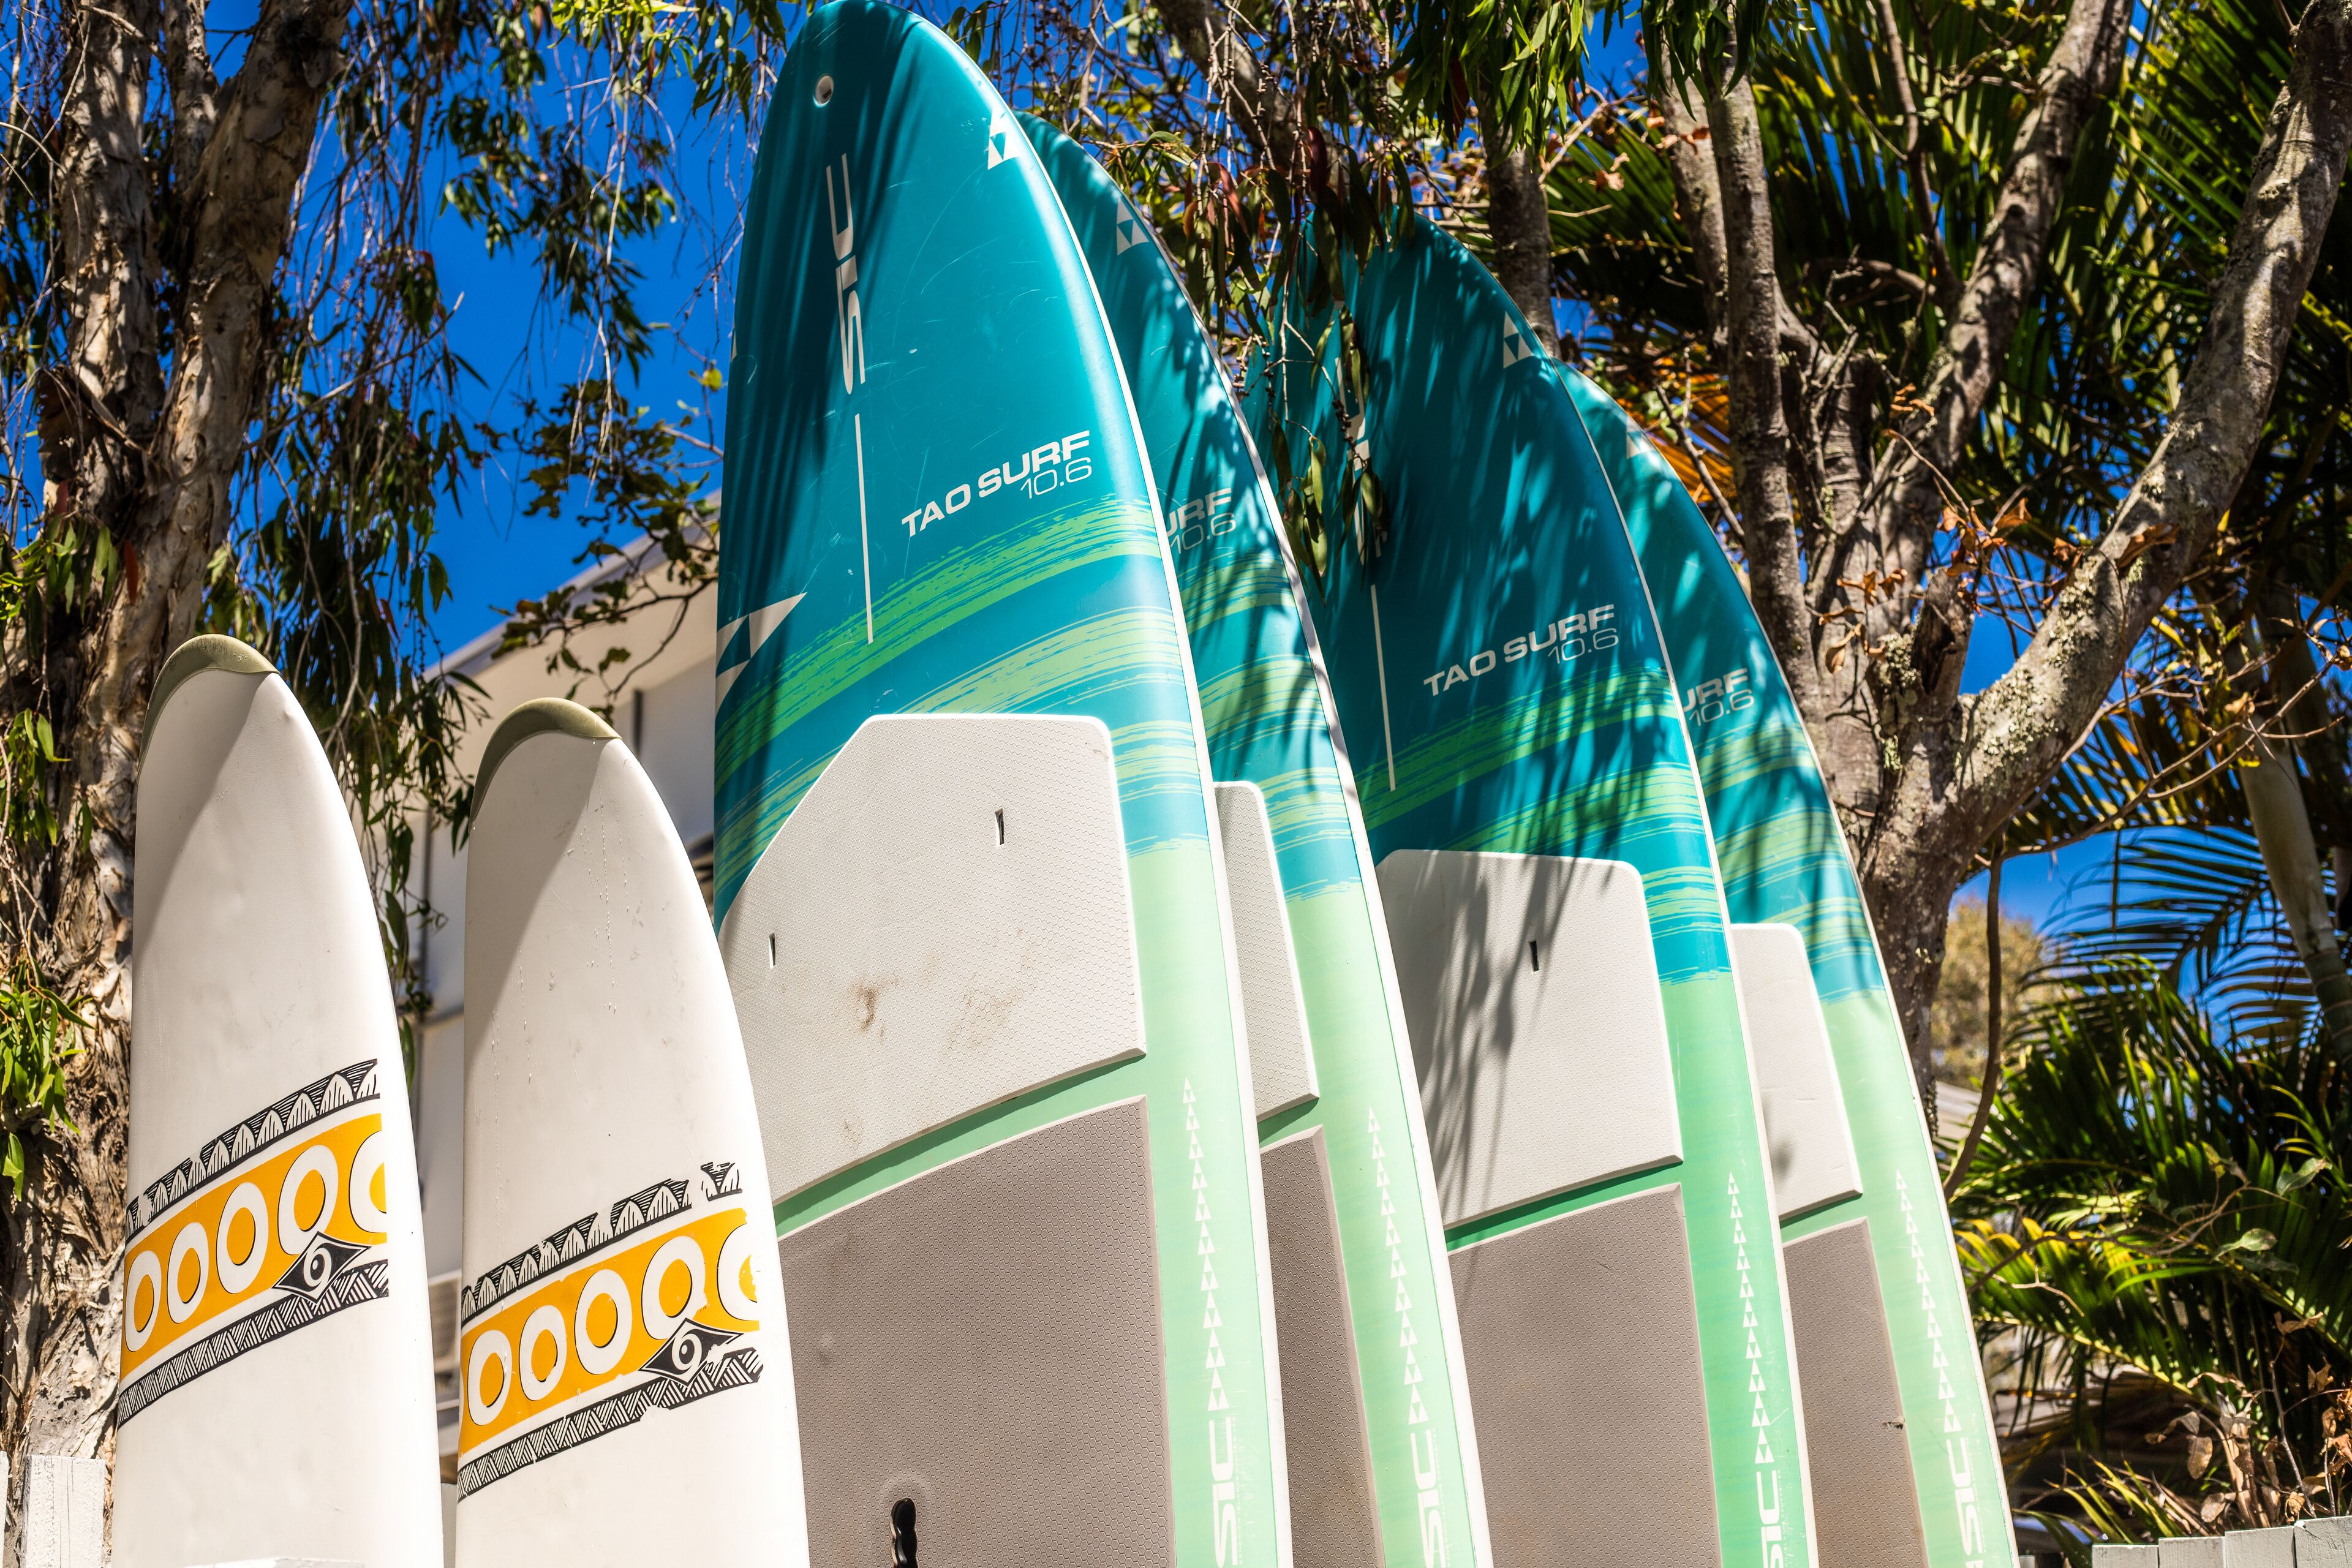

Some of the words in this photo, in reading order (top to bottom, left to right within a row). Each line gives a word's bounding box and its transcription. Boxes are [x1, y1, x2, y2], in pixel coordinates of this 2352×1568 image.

[827, 153, 865, 394] SIC
[902, 483, 971, 537] TAO
[978, 429, 1090, 498] SURF
[1020, 457, 1092, 499] 10.6
[1167, 488, 1232, 537] URF
[1170, 512, 1237, 554] 10.6
[1424, 650, 1496, 696] TAO
[1504, 604, 1615, 663] SURF
[1548, 628, 1619, 664] 10.6
[1683, 668, 1749, 712] URF
[1689, 688, 1755, 726] 10.6
[1209, 1416, 1240, 1568] SIC
[1411, 1429, 1447, 1568] SIC
[1947, 1437, 1983, 1555] SIC
